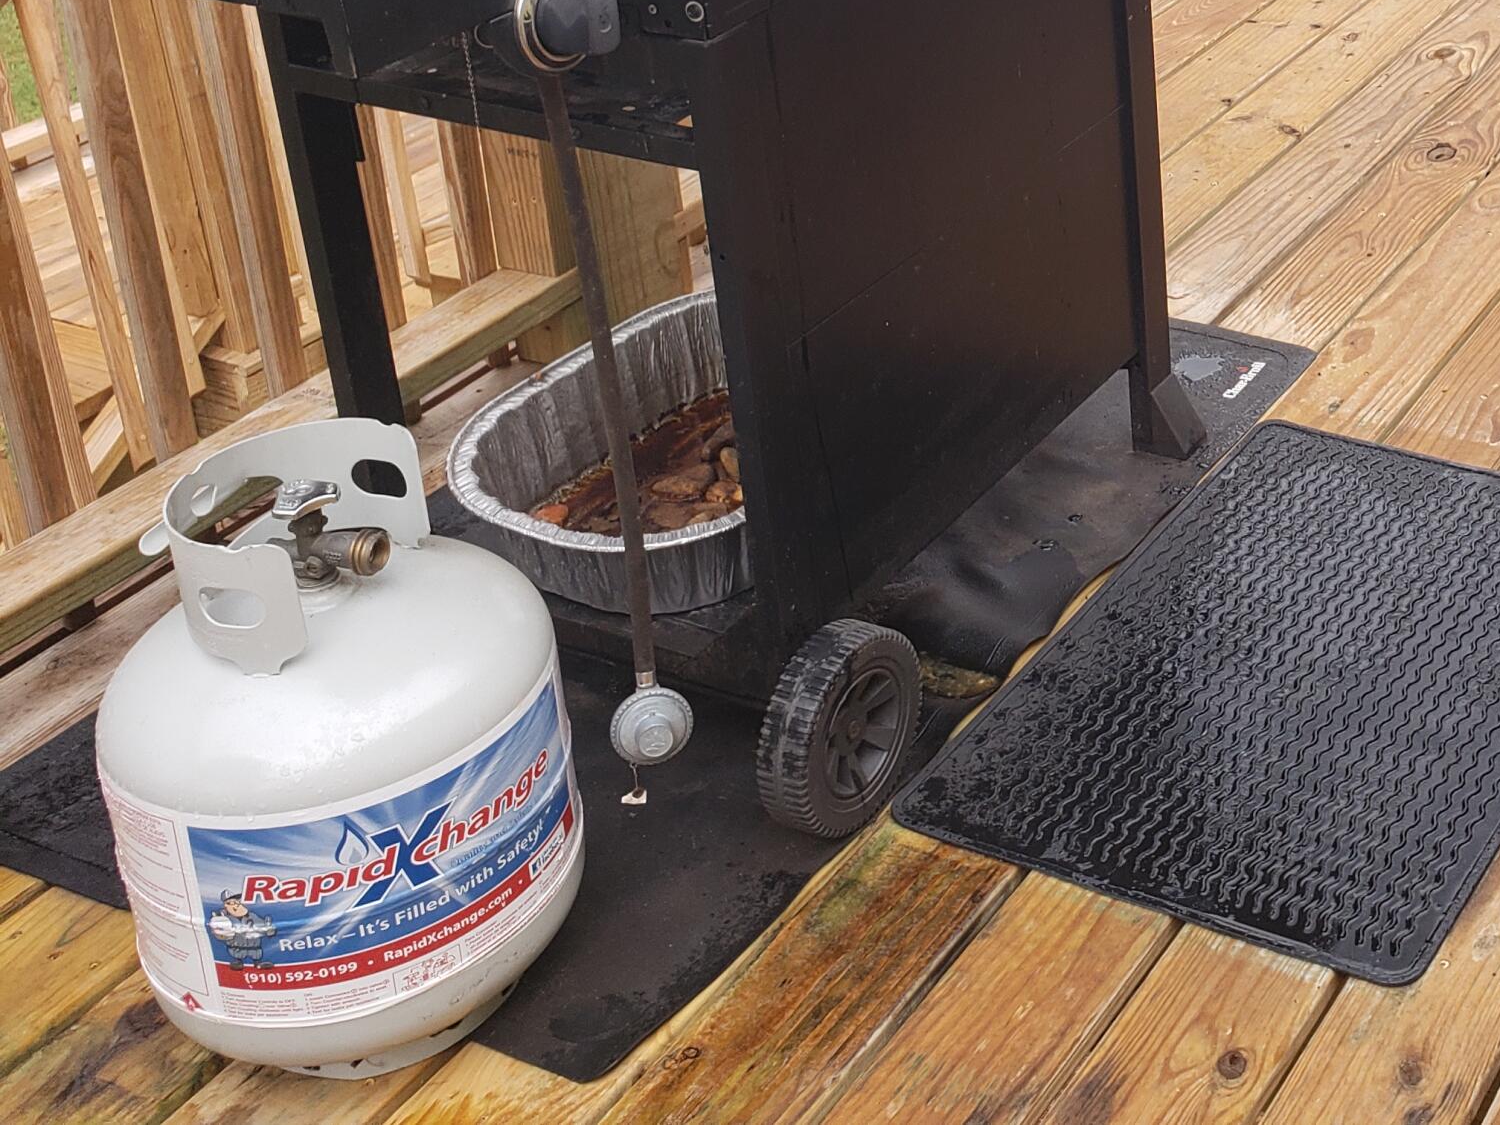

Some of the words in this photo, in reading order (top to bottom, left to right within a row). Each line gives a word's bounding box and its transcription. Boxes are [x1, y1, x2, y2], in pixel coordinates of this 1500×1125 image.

[244, 972, 282, 985] (910)
[285, 961, 358, 983] 592-0199
[383, 887, 513, 963] RapidXchange.com
[279, 932, 338, 952] Relax
[394, 892, 450, 925] Filled
[455, 866, 493, 896] with
[497, 818, 544, 869] Safety!
